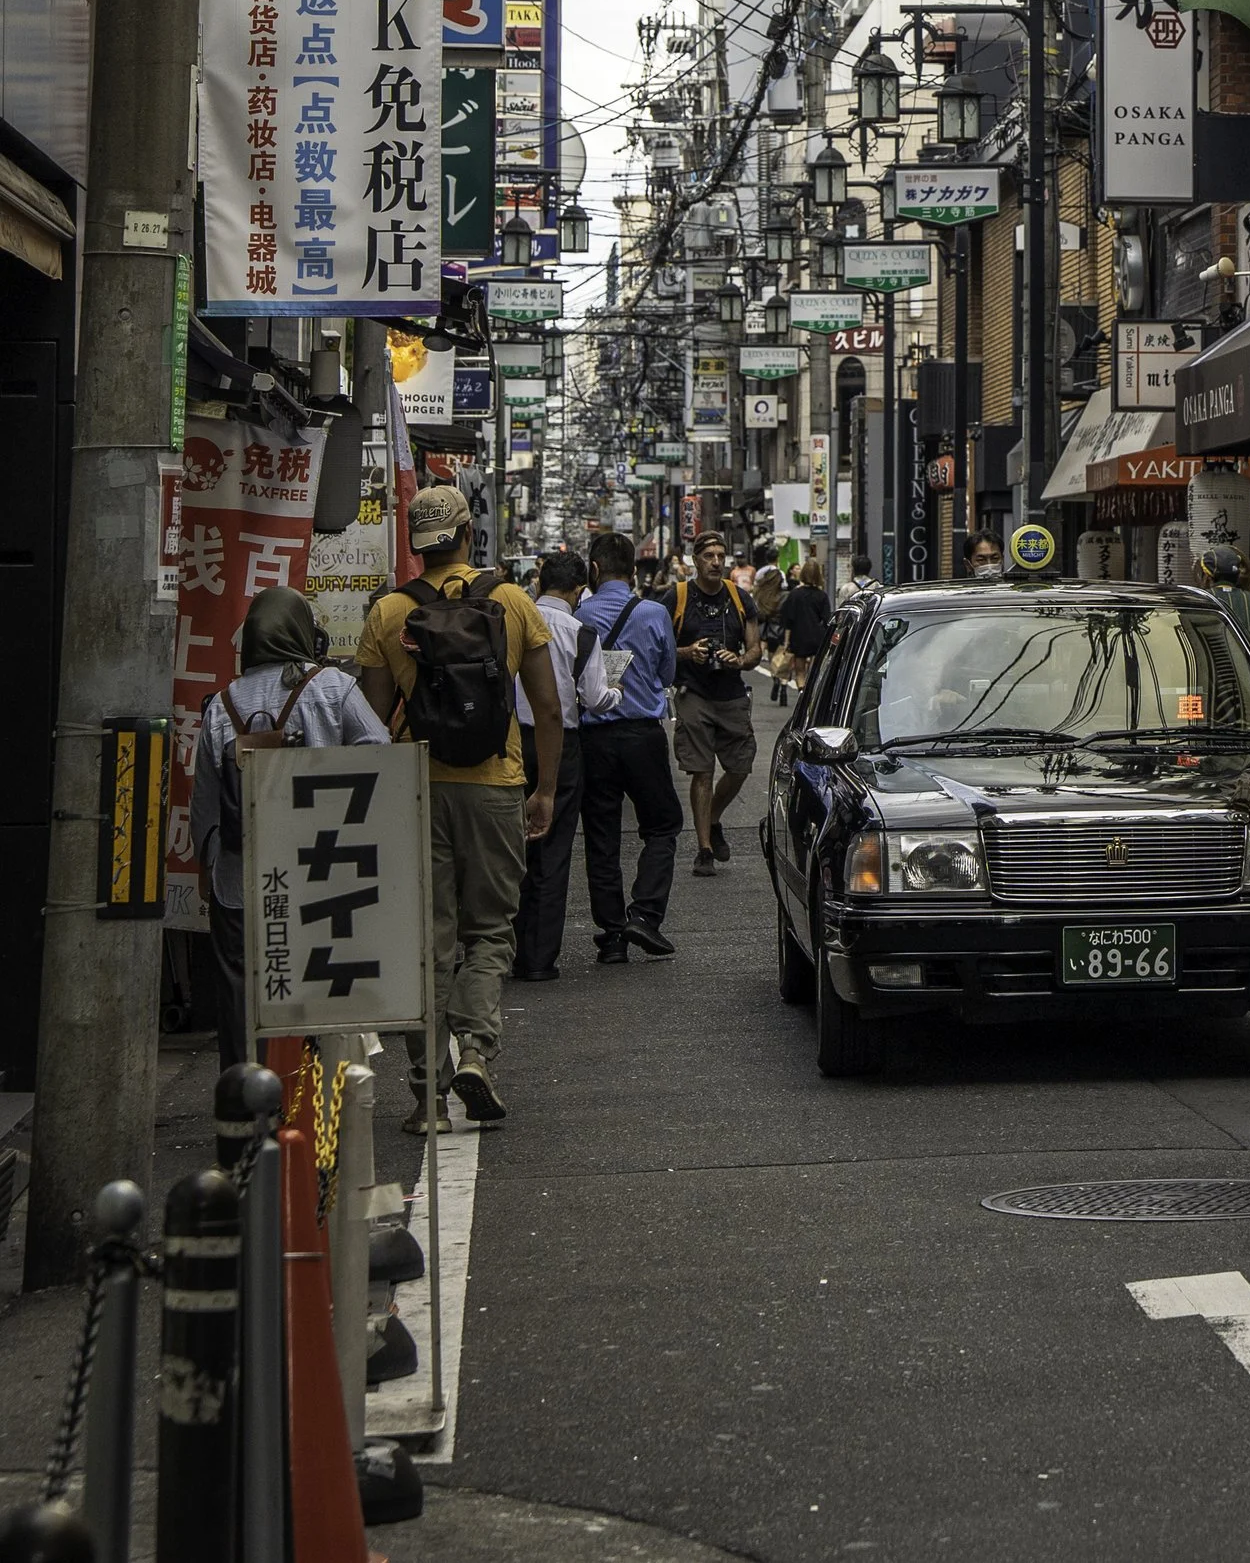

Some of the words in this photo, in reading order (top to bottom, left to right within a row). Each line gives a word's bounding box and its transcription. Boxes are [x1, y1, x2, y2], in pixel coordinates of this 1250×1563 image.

[509, 9, 540, 21] TAKA
[1114, 106, 1186, 120] OSAKA
[1114, 132, 1186, 146] PANGA
[921, 207, 976, 217] 三ツ寺筋
[865, 278, 911, 287] 三ツ寺筋
[1126, 327, 1135, 350] Sumi
[1126, 355, 1135, 388] Yakitori
[1146, 369, 1176, 387] mi
[405, 405, 444, 415] URGER
[1183, 391, 1208, 426] OSAKA
[1209, 383, 1235, 419] PANGA
[240, 442, 312, 484] 免税
[239, 482, 309, 502] TAXFREE
[305, 576, 346, 592] DUTY
[292, 772, 381, 998] ワカイケ
[262, 866, 292, 1001] 水曜日定休
[1070, 958, 1085, 971] い
[1088, 947, 1169, 978] 89-66
